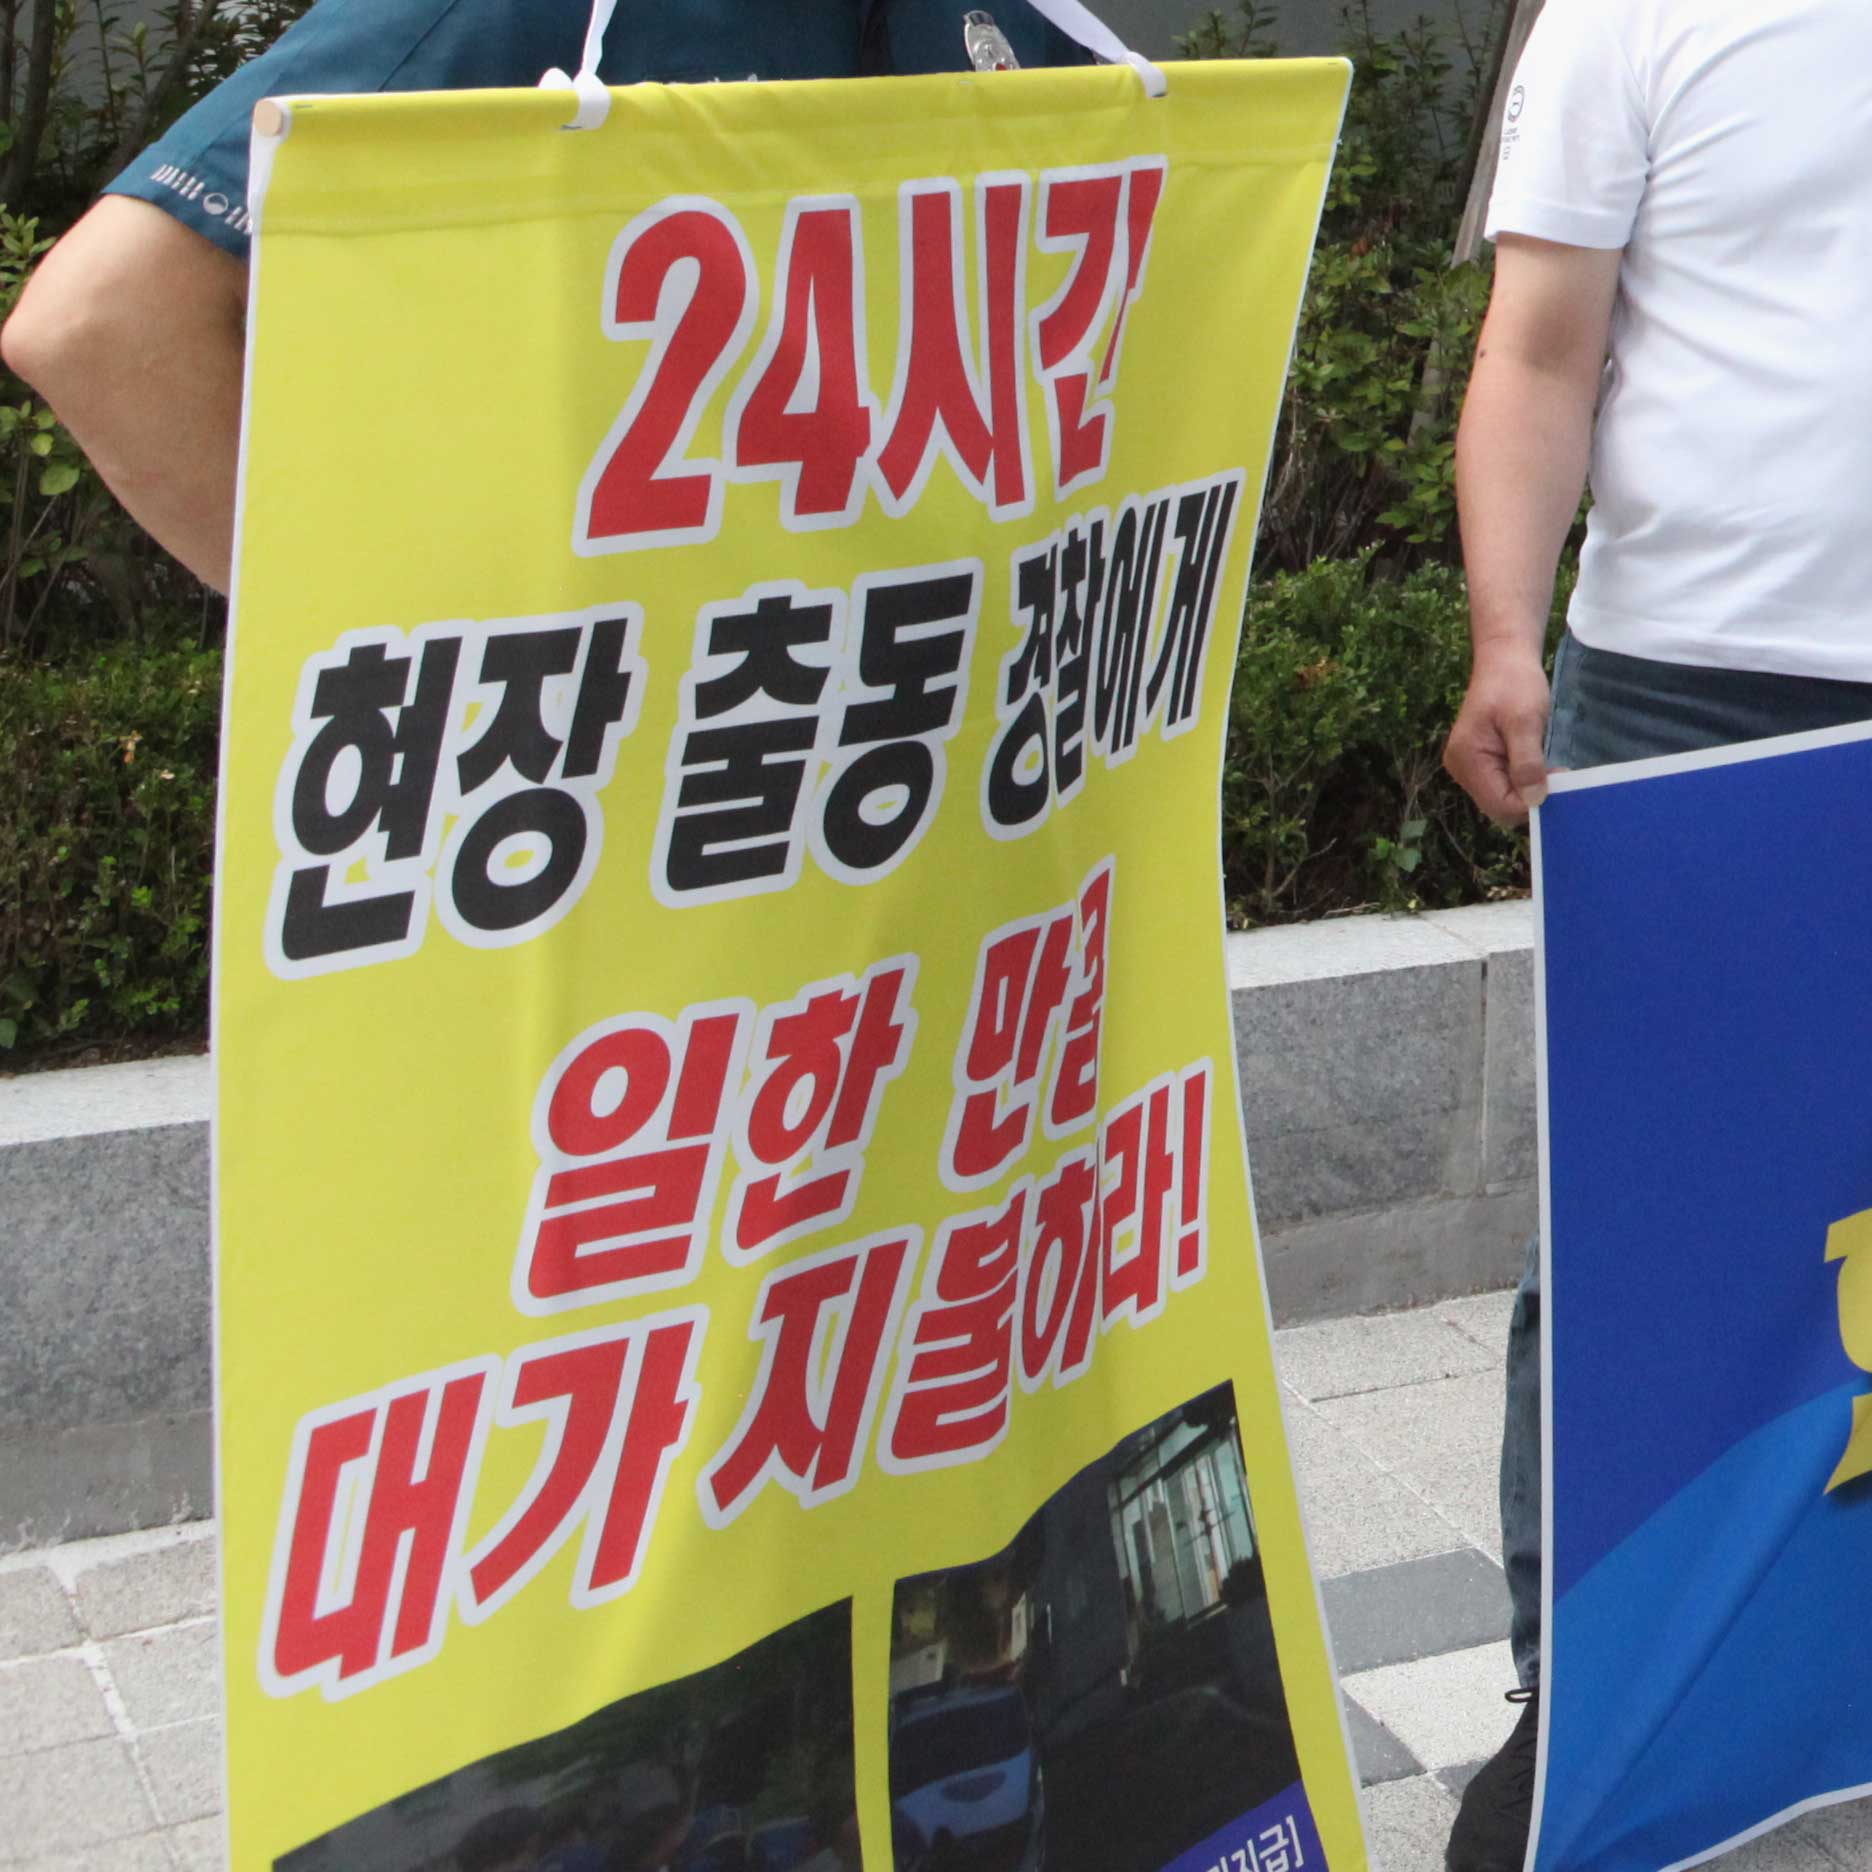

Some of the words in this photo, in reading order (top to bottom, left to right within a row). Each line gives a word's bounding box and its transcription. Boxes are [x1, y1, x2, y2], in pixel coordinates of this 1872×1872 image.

[588, 168, 1163, 539] 24시간
[282, 619, 630, 961] 현장
[666, 573, 973, 891] 출동
[988, 480, 1238, 826] 경찰에게
[528, 968, 906, 1299] 일한
[271, 1320, 697, 1684] 대가
[710, 1069, 1207, 1511] 지불하라!
